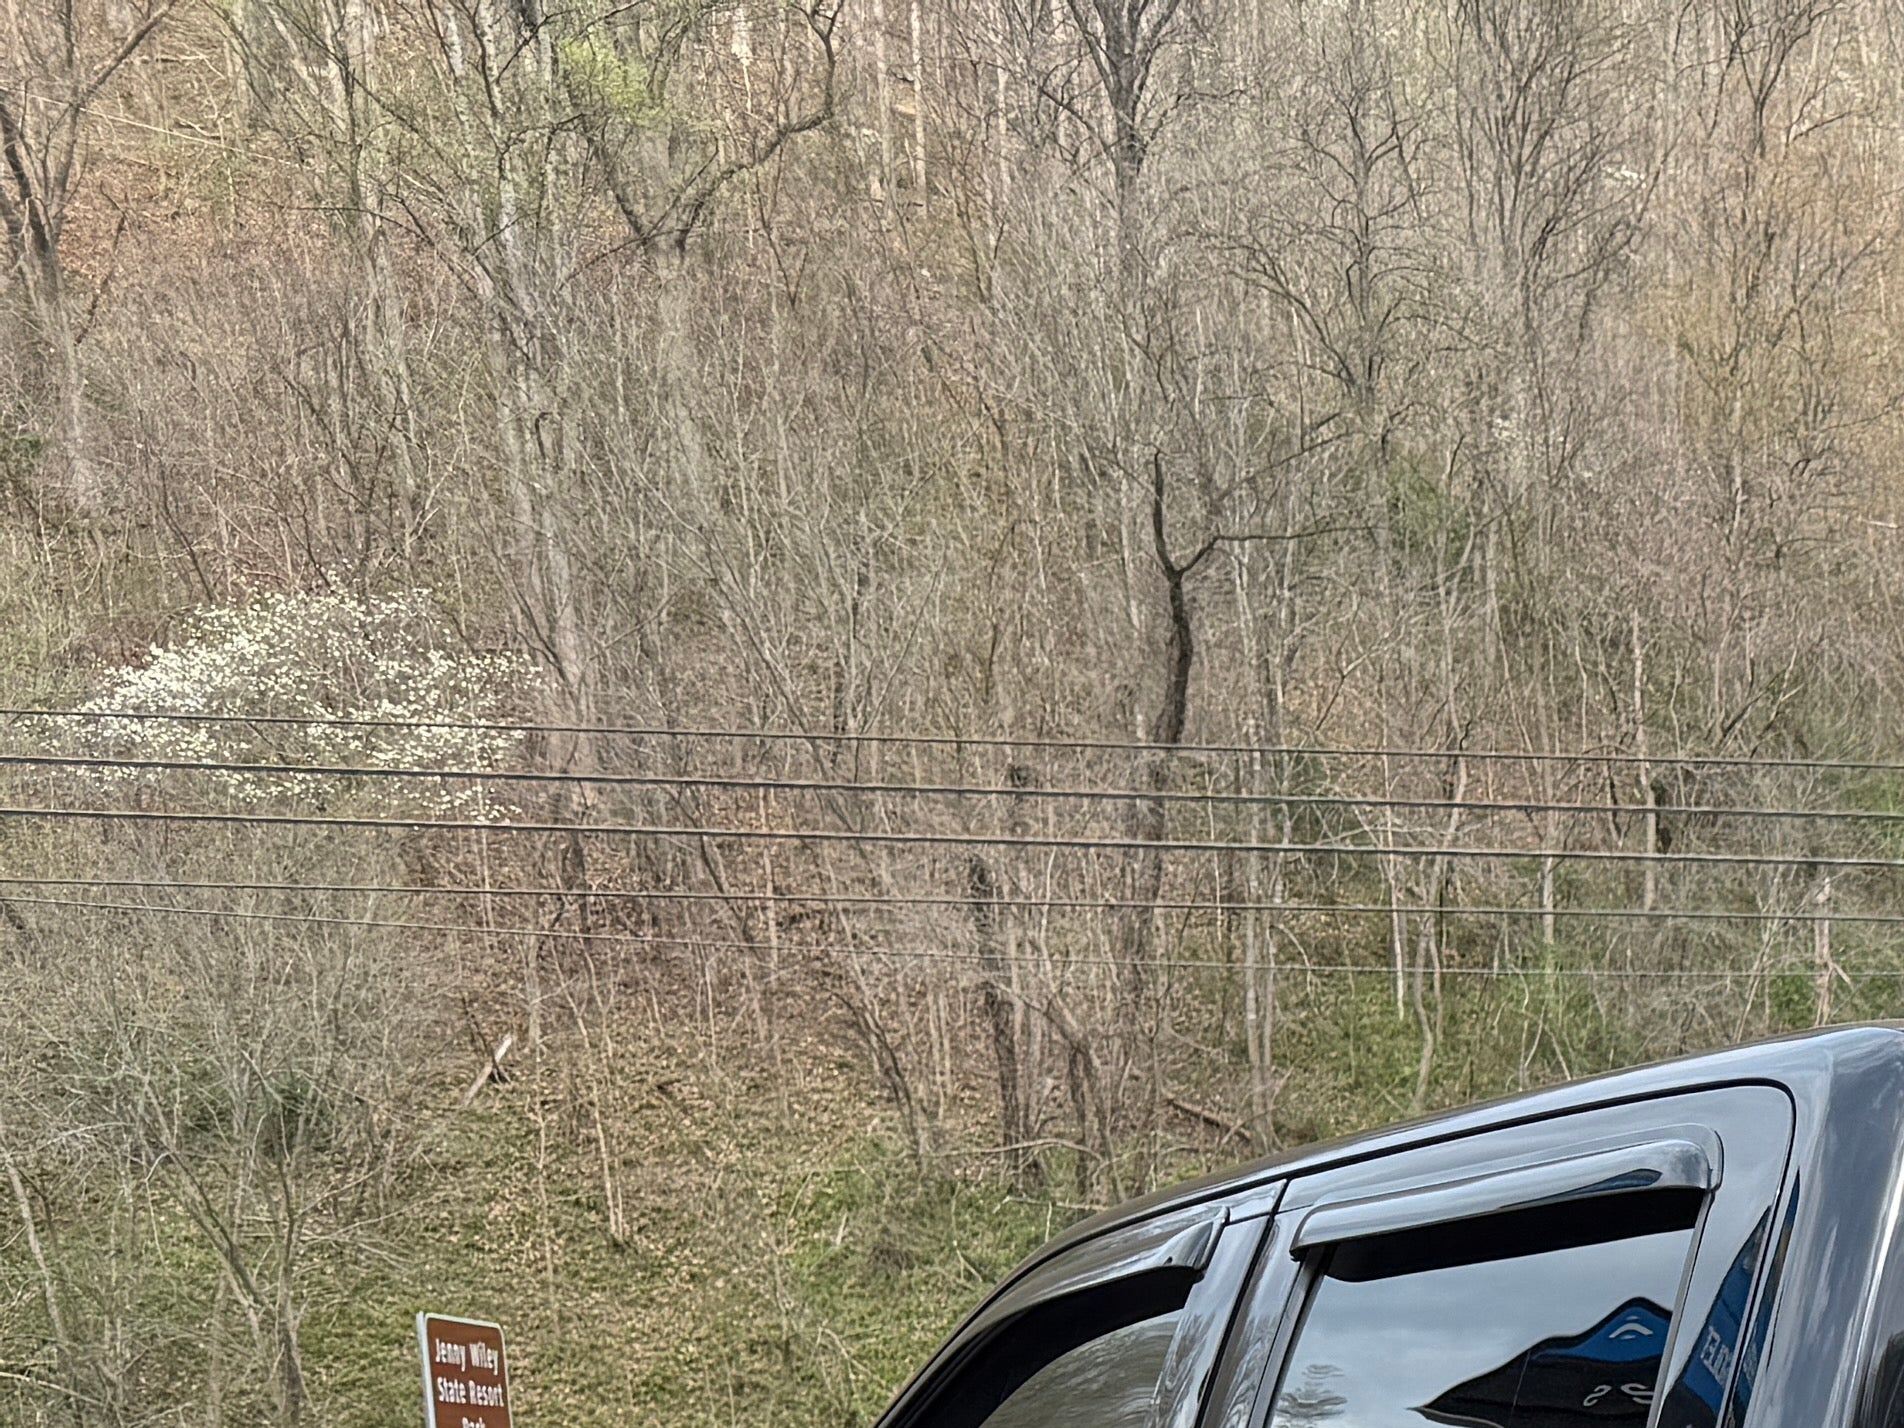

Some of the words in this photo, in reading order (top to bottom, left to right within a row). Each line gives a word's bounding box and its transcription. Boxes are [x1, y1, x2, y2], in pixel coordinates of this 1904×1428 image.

[435, 1338, 466, 1372] Jenny
[437, 1376, 467, 1404] State
[469, 1380, 504, 1407] Resort
